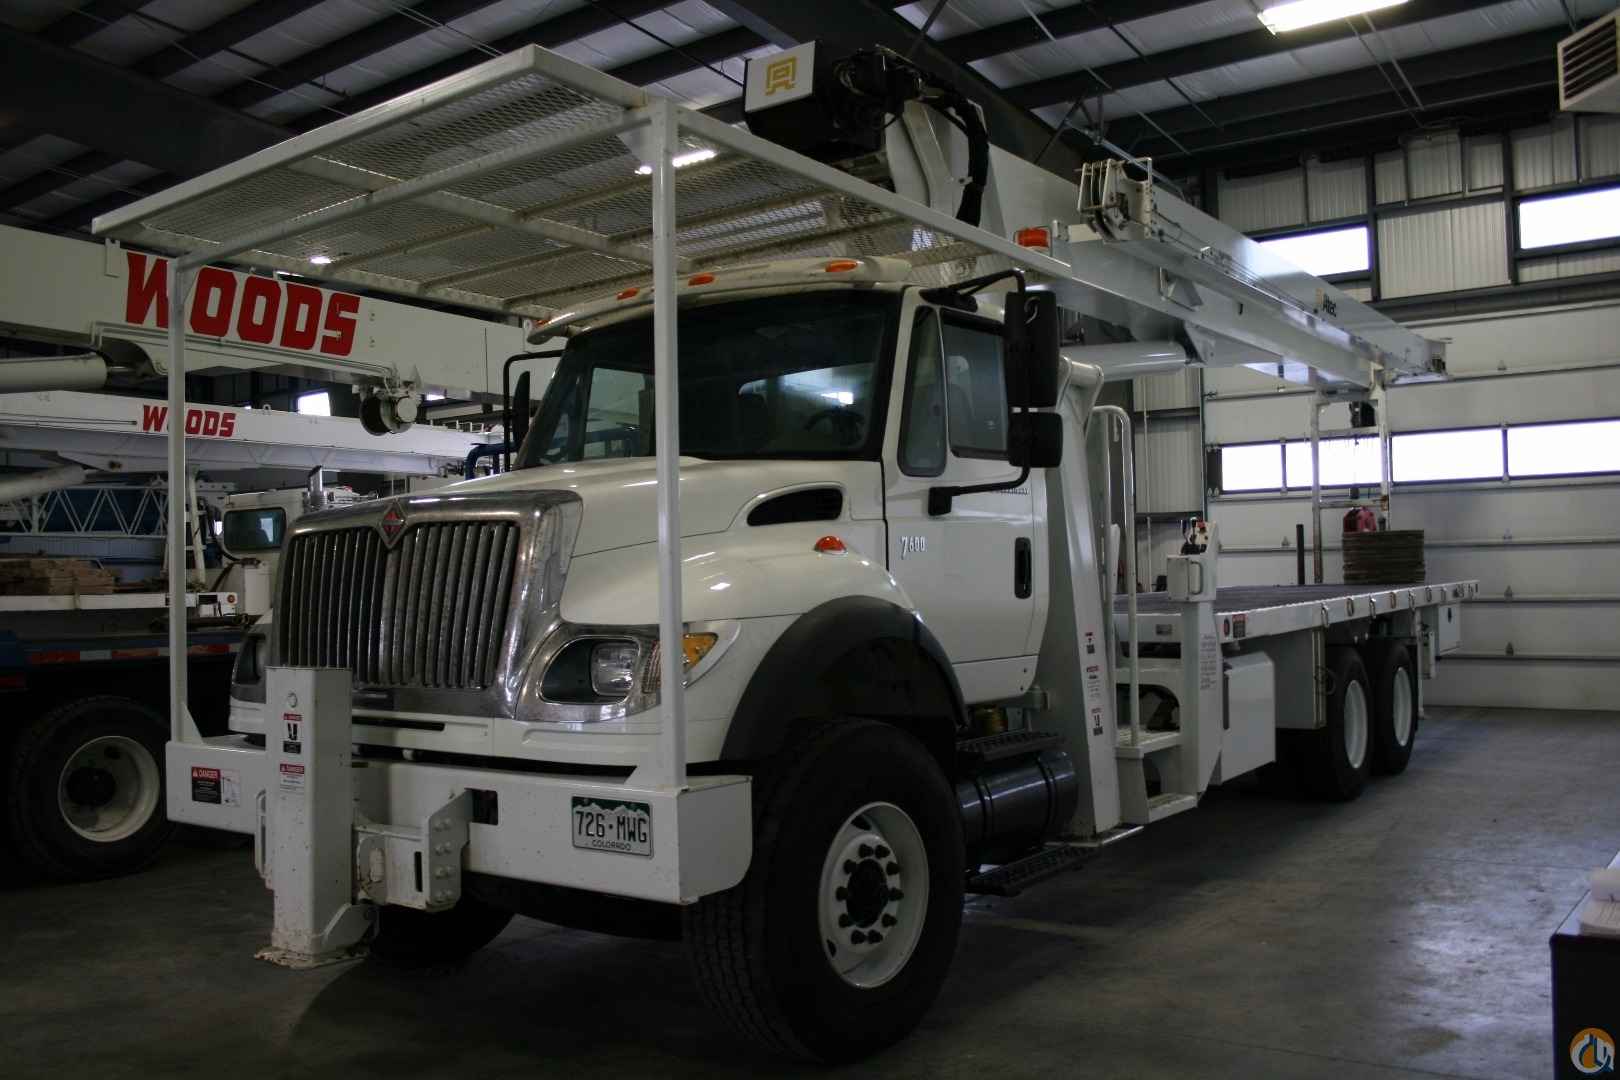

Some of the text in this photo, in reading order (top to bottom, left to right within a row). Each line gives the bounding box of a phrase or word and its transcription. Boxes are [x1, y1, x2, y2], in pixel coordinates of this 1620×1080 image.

[126, 251, 361, 356] WOODS
[143, 405, 236, 438] WODS
[901, 536, 926, 559] 7600
[592, 840, 632, 851] COLORADO
